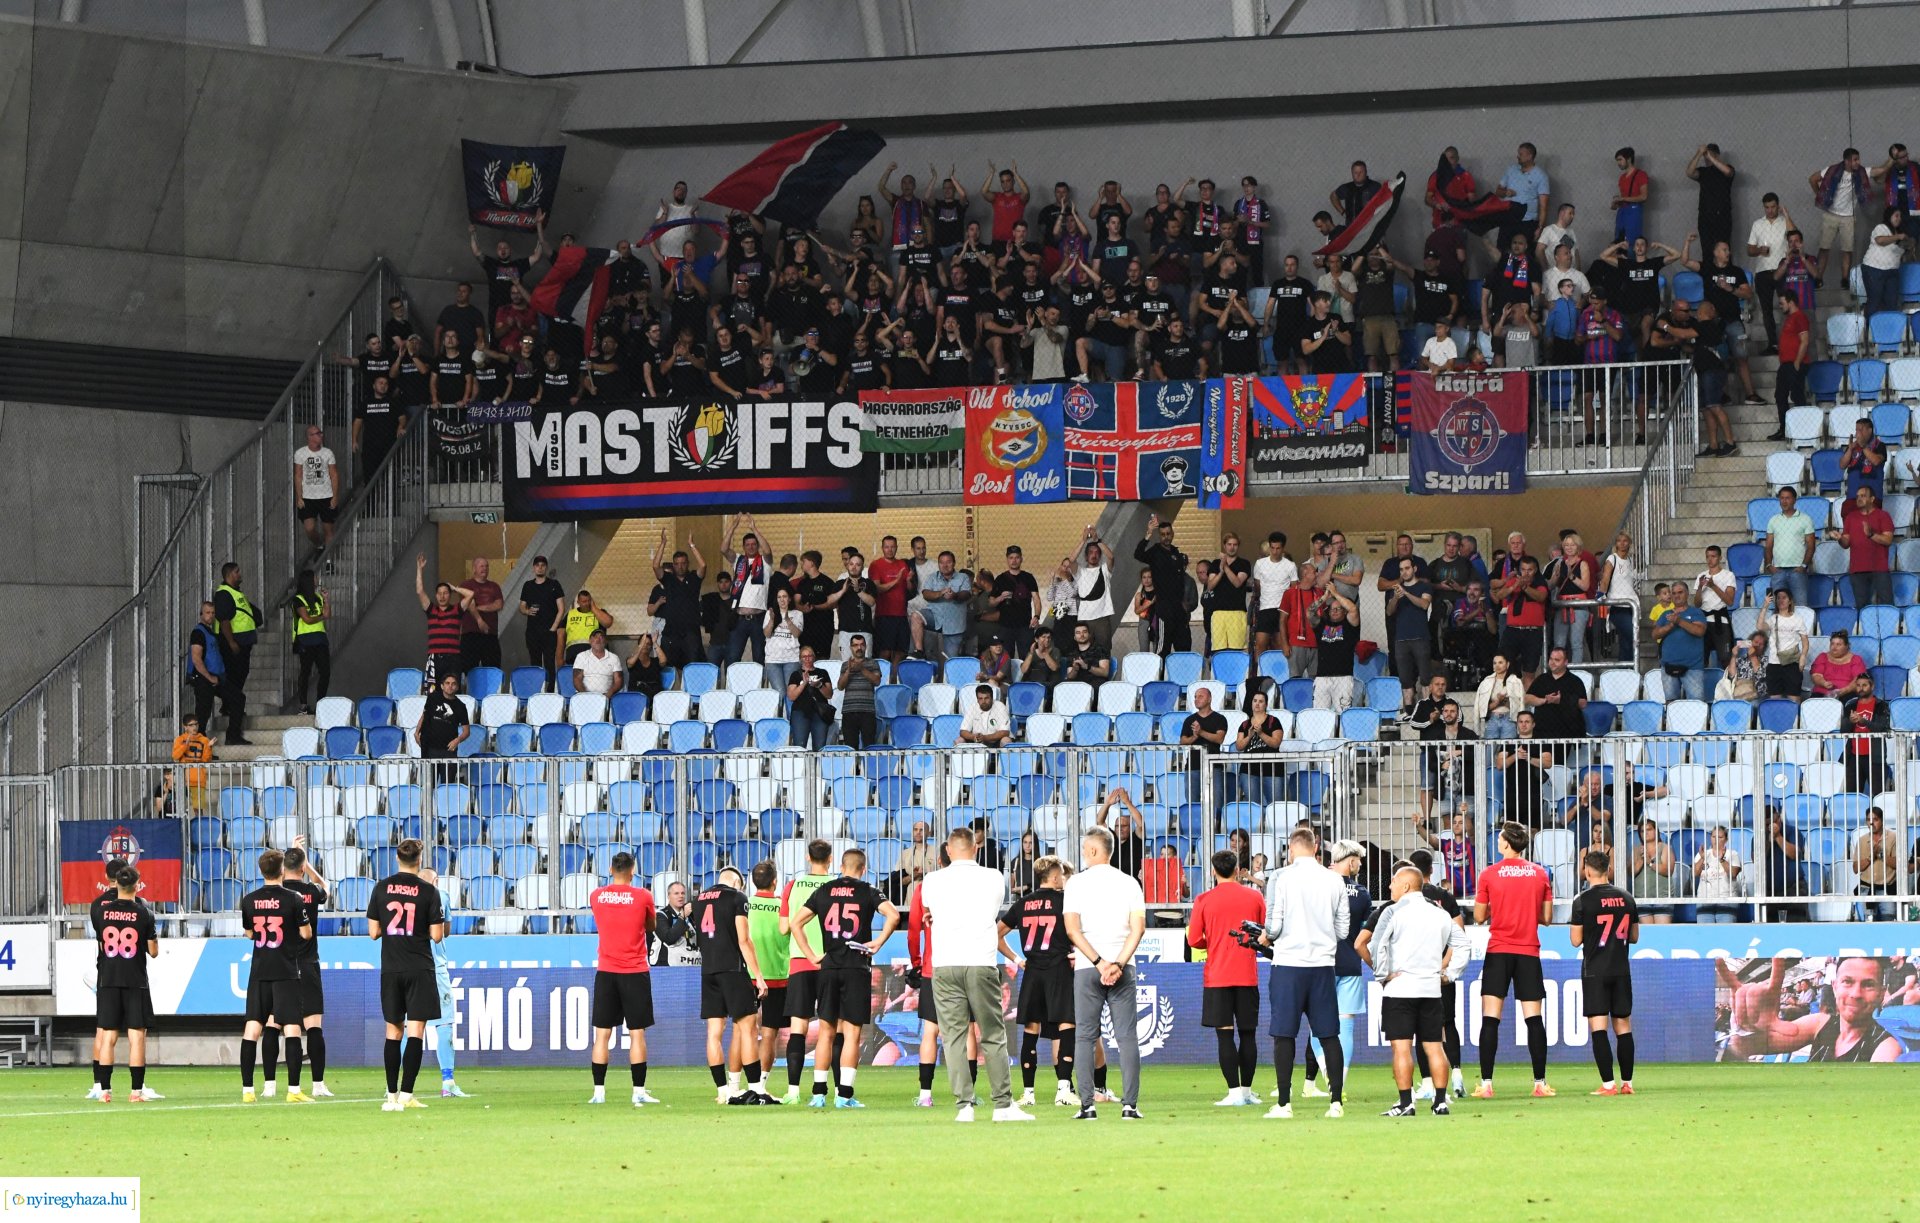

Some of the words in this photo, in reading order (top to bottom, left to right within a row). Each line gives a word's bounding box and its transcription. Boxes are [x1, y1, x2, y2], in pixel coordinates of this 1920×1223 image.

[969, 387, 994, 409] Old
[1002, 384, 1056, 409] School
[1435, 375, 1504, 396] Hajrá
[863, 397, 961, 416] MAGYARORSZÁG
[1166, 395, 1186, 404] 1928
[1384, 391, 1393, 425] FRONT
[876, 423, 949, 439] PETNEHÁZA
[1456, 419, 1468, 431] NY
[514, 402, 863, 480] MASTIFFS
[550, 420, 559, 471] 1995
[1064, 431, 1196, 450] Nyíregyháza
[1257, 443, 1366, 462] NYÍREGYHÁZA
[970, 473, 1011, 496] Best
[1018, 469, 1060, 497] Style
[1425, 471, 1510, 493] Szpari!
[254, 898, 280, 909] TAMÁS
[1024, 900, 1043, 910] NAGY
[1045, 900, 1052, 910] B.
[1601, 897, 1625, 907] PINTE
[103, 911, 137, 921] FARKAS
[386, 901, 416, 936] 21
[701, 904, 716, 938] 4
[824, 903, 860, 938] 45
[253, 916, 284, 949] 33
[1022, 916, 1056, 951] 77
[1597, 914, 1631, 946] 74
[102, 925, 138, 959] 88
